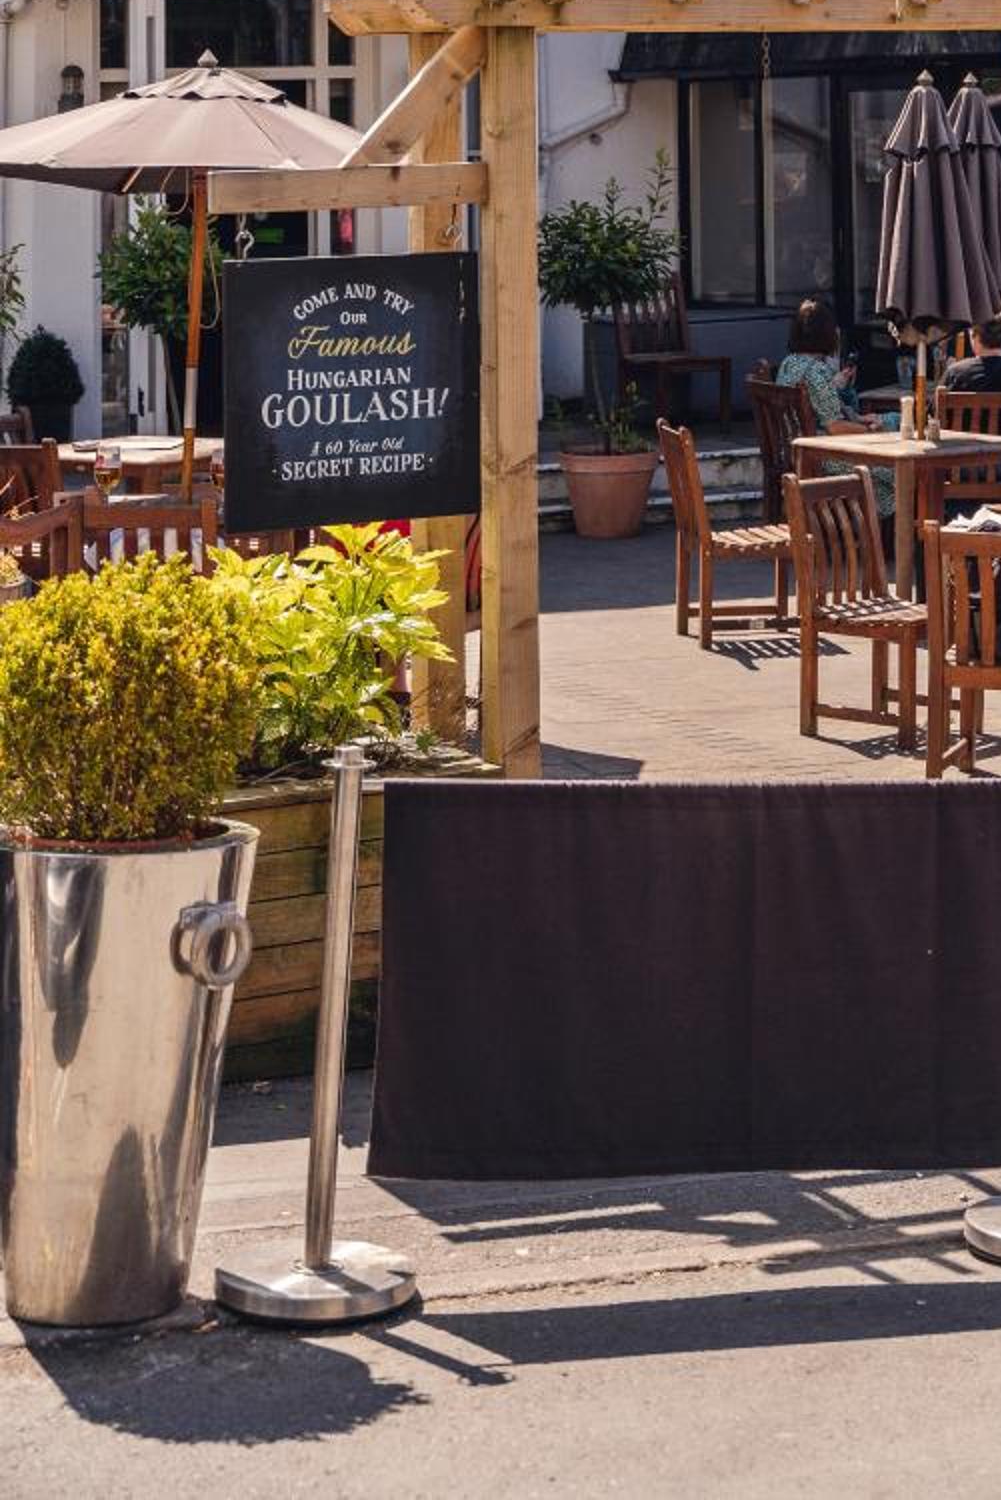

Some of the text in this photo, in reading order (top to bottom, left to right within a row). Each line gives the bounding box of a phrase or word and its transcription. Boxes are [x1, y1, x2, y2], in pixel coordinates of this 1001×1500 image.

[293, 284, 415, 320] COME AND TRY
[288, 325, 417, 359] Famous
[287, 366, 412, 391] HUNGARIAN
[261, 387, 449, 429] GOULASH!
[325, 440, 343, 455] 60
[349, 439, 378, 454] Year
[381, 435, 405, 451] Old
[281, 453, 425, 481] SECRET RECIPE
